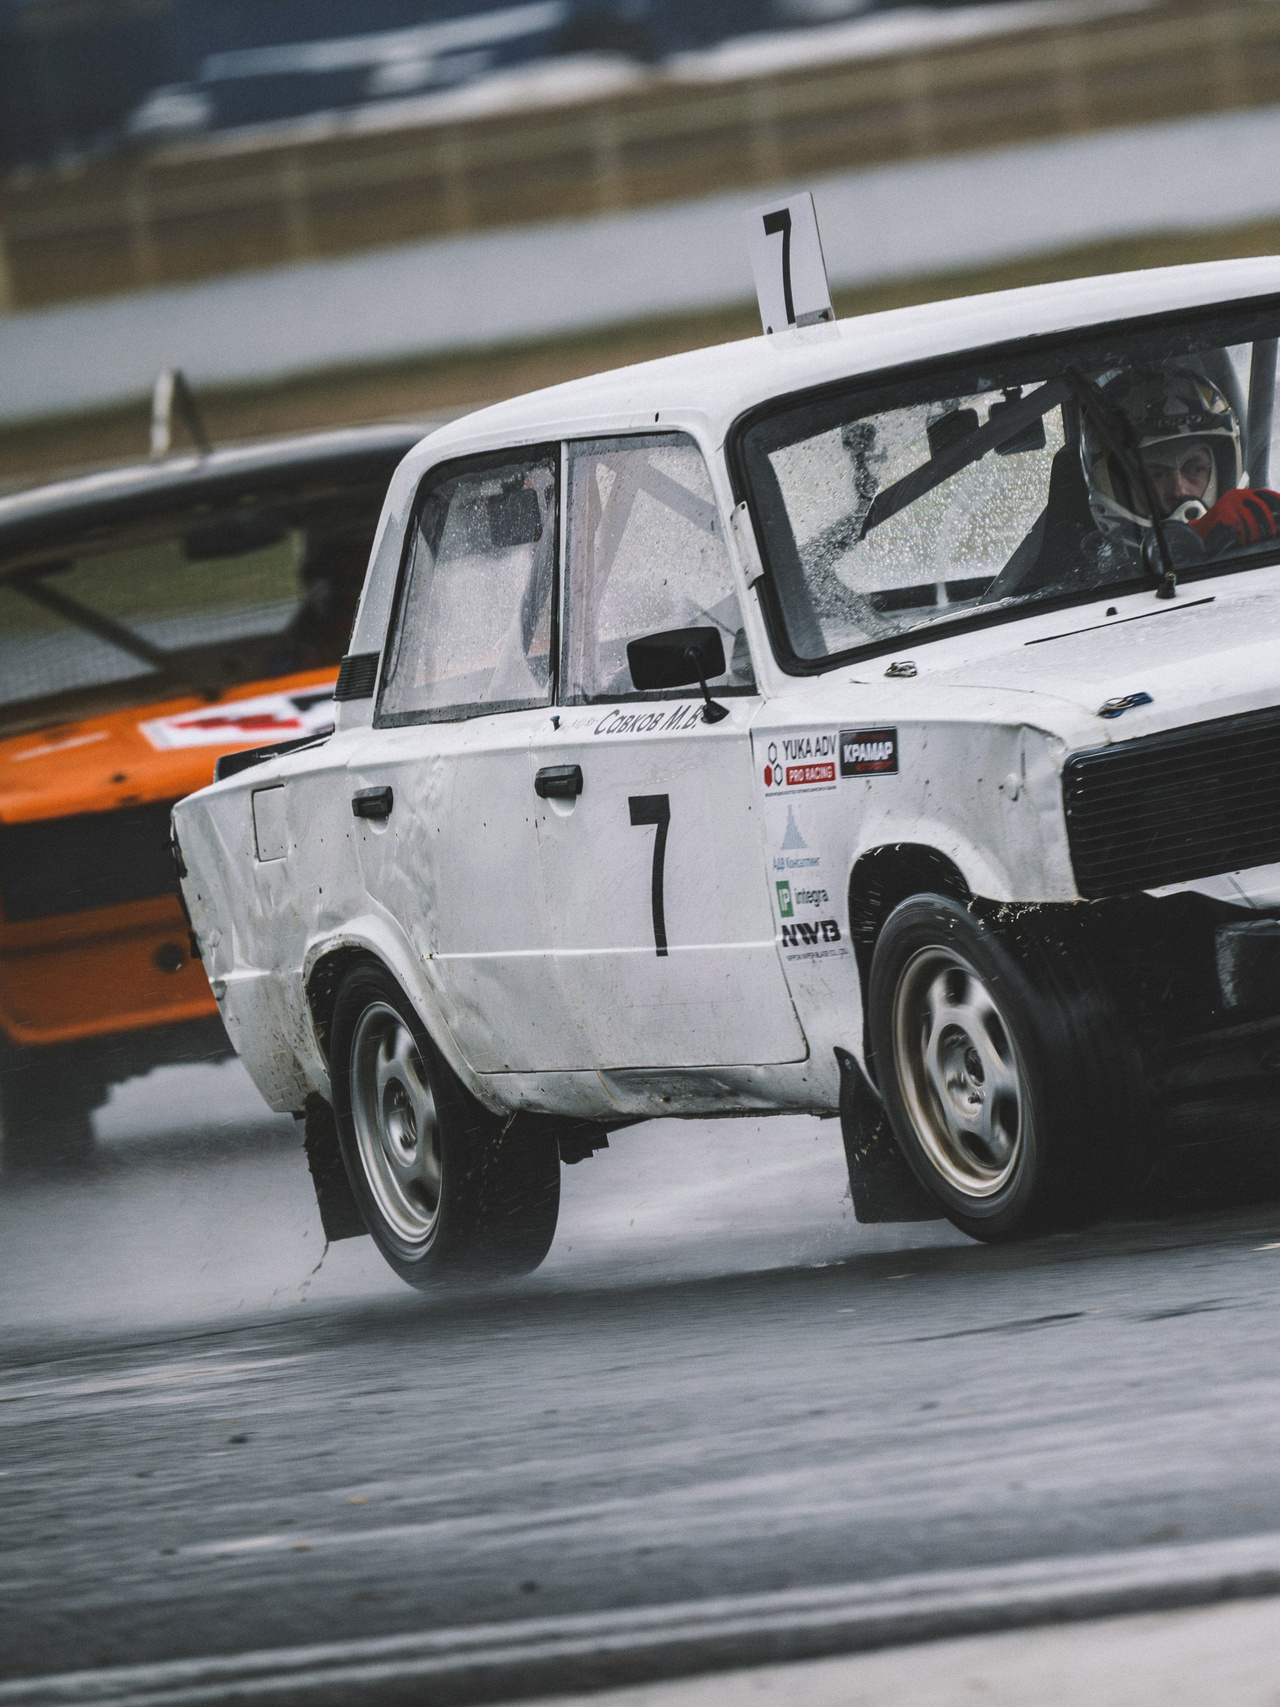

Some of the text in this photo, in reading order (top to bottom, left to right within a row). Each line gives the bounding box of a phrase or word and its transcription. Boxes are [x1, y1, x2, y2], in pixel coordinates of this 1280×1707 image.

[762, 207, 796, 325] 7
[594, 708, 665, 735] Савков
[782, 734, 837, 760] YUKA ADV
[843, 741, 894, 763] КРАМАР
[788, 765, 833, 783] PRO RACING
[628, 793, 671, 957] 7
[794, 887, 829, 908] integra
[781, 919, 841, 947] NWB
